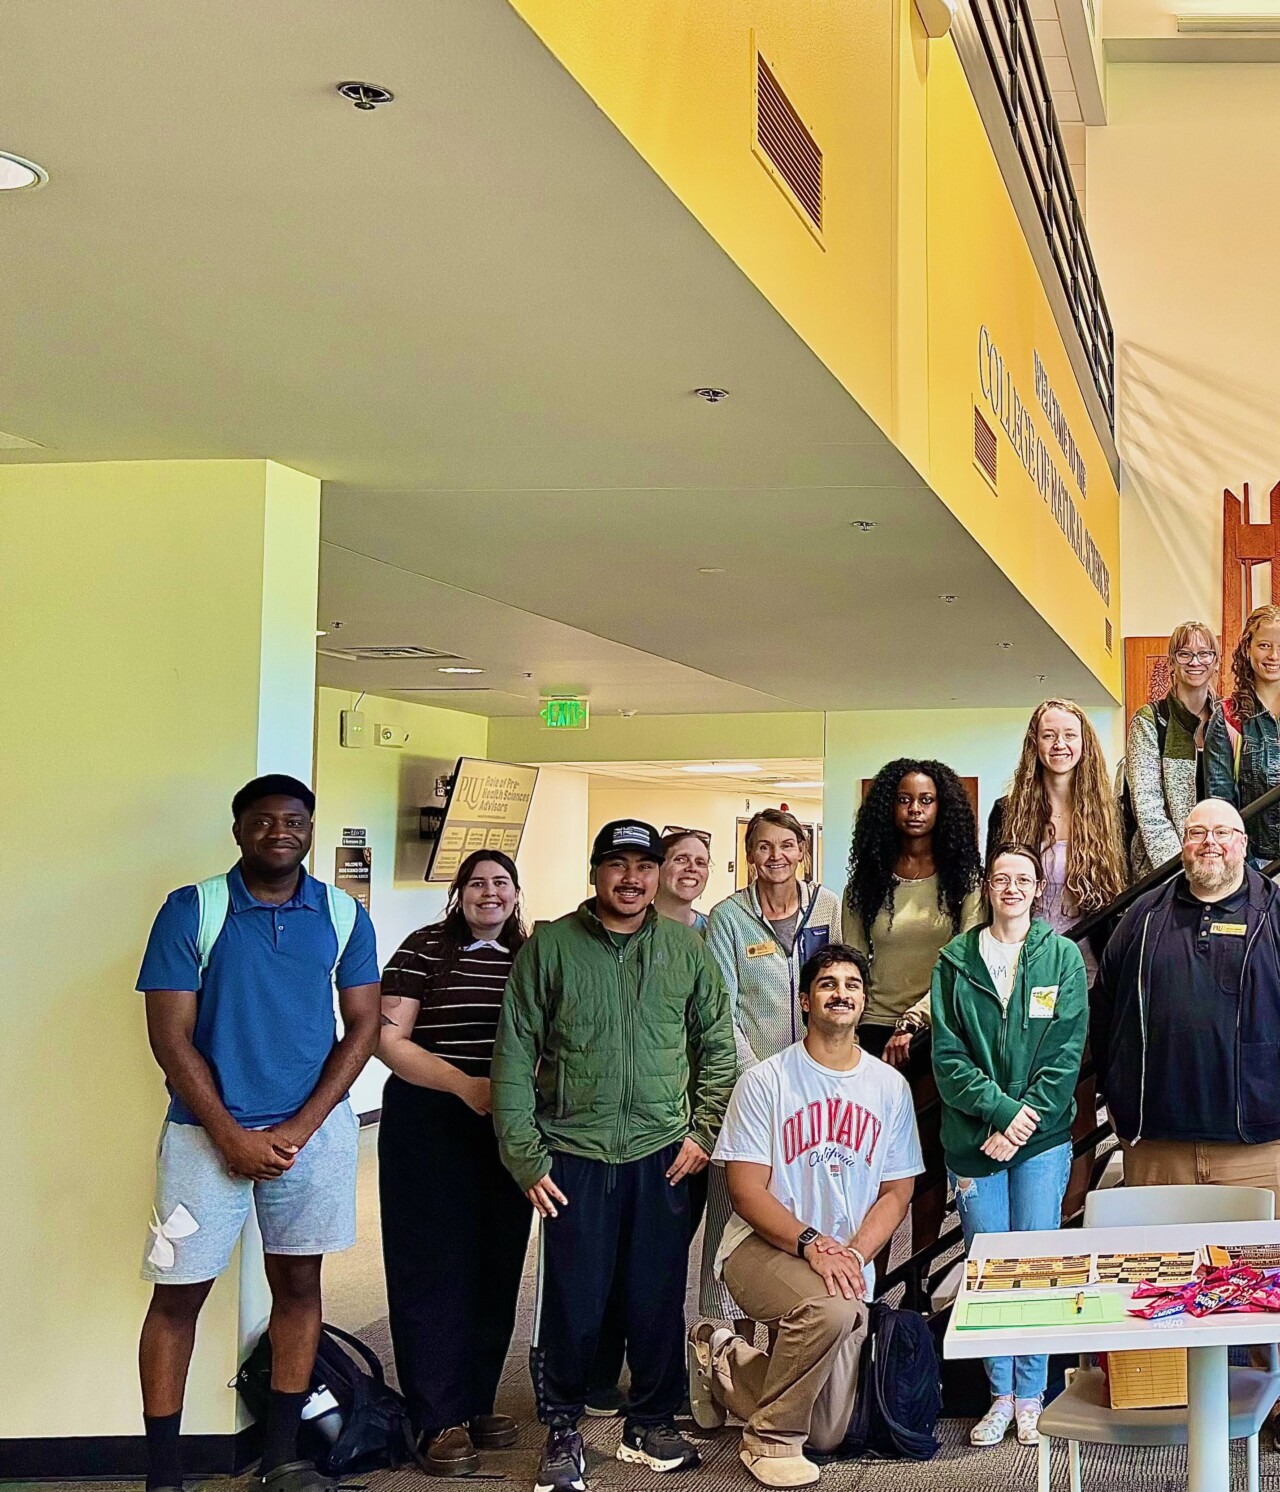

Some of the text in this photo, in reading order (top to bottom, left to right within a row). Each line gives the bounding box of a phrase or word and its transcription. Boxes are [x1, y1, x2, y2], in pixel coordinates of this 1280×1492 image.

[1033, 348, 1087, 500] WELCOME TO THE
[979, 324, 1110, 609] COLLEGE OF NATURAL SCIENCES
[547, 701, 581, 727] EXIT
[455, 776, 485, 811] PLU
[482, 788, 531, 803] Health Sciences
[485, 776, 499, 788] Role
[499, 777, 508, 788] of
[479, 800, 508, 813] Advisors
[782, 1099, 822, 1166] OLD
